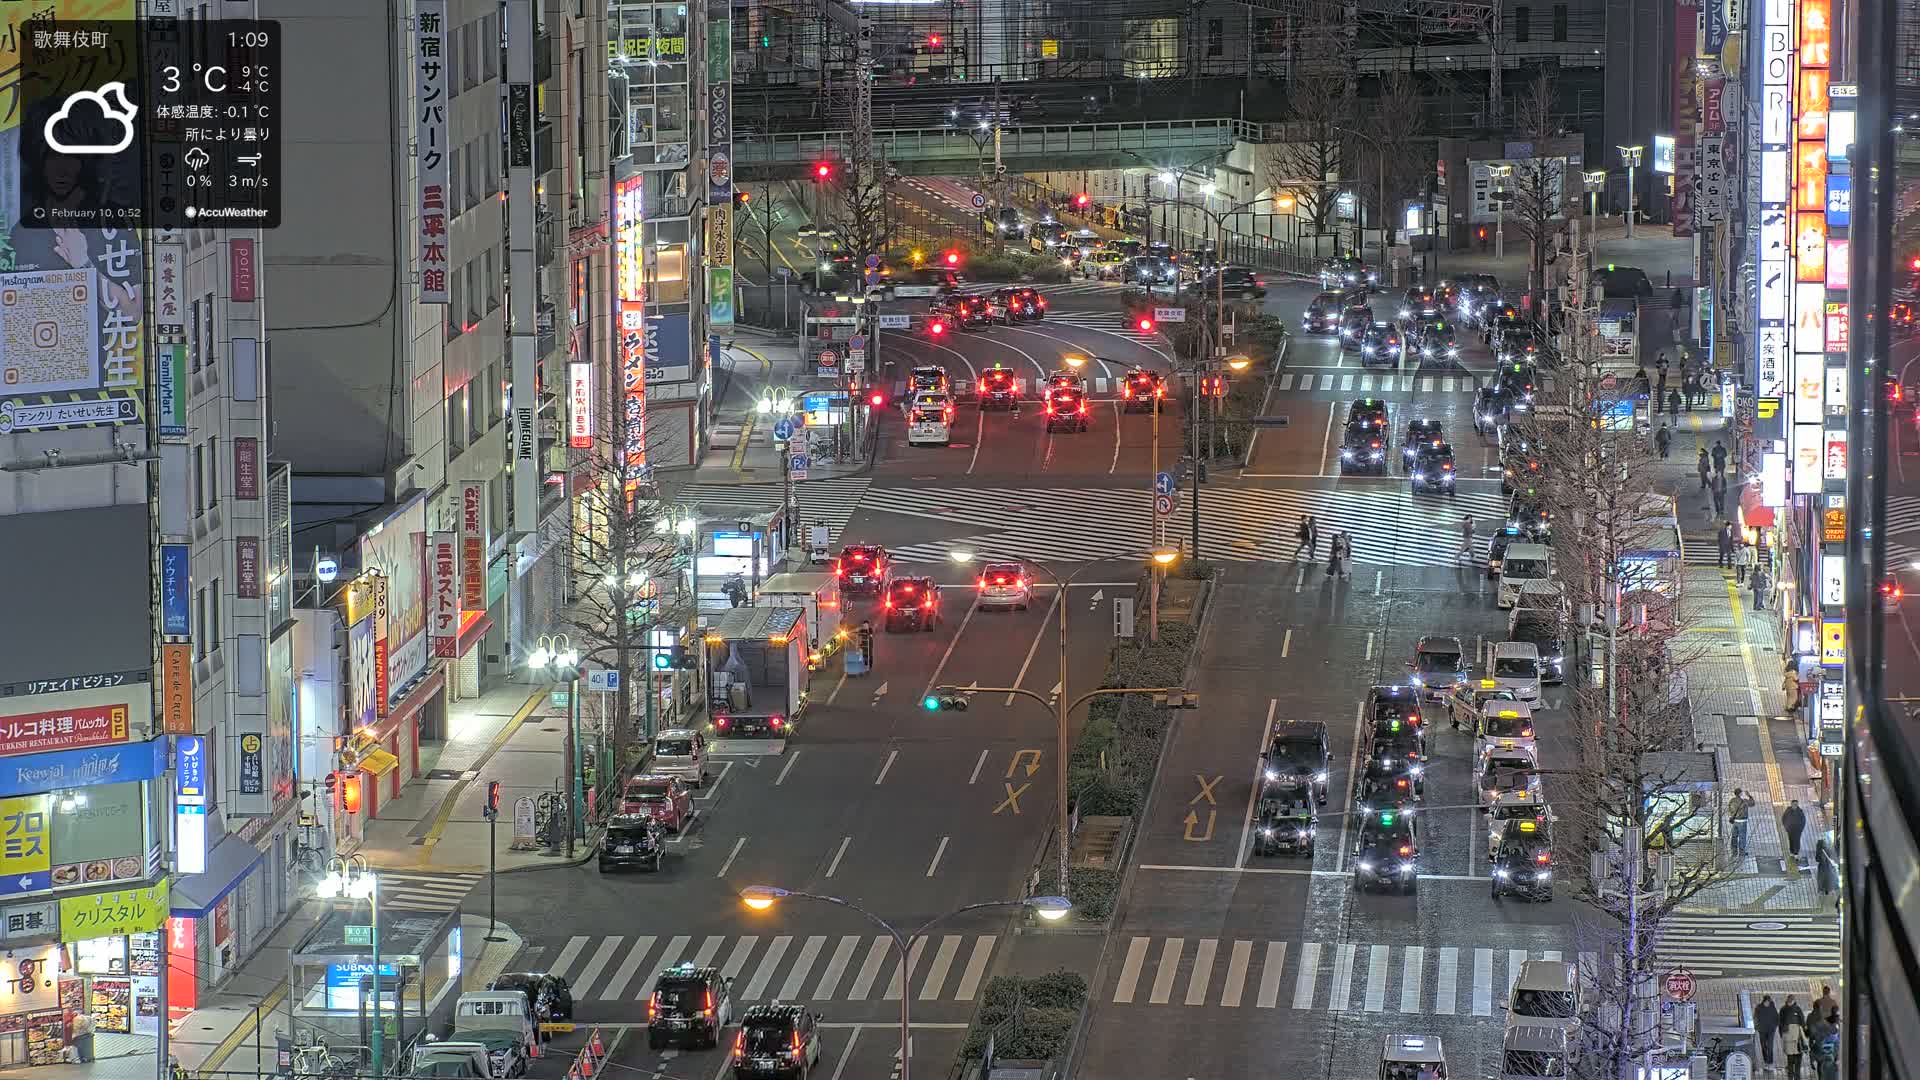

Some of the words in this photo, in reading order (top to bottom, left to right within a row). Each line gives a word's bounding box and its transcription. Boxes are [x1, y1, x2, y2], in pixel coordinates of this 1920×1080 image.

[1712, 0, 1721, 47] ントラル
[660, 37, 684, 54] 夜間
[420, 12, 443, 170] 新宿サンパーク
[1709, 88, 1720, 120] アコム
[423, 185, 445, 292] 三平本館
[715, 208, 727, 263] 肉汁水餃子
[624, 332, 640, 388] ラーメン
[1763, 331, 1775, 381] 大衆酒場
[161, 354, 173, 415] FamilyMart
[18, 409, 53, 422] テンクリ
[58, 405, 114, 420] たいせい先生
[519, 408, 532, 460] HOMEGAME
[465, 488, 475, 531] GAME
[164, 556, 176, 606] ゲウチャイ
[437, 543, 453, 630] 三平ストア
[28, 679, 79, 694] リアエイド
[82, 674, 123, 688] ビジョン
[114, 712, 122, 736] 5F
[29, 735, 73, 747] RESTAURANT
[247, 736, 258, 751] 占
[3, 812, 44, 836] プロ
[4, 838, 44, 858] ミス
[8, 912, 43, 932] 囲碁
[73, 904, 146, 927] クリスタル
[336, 964, 388, 973] SUBNAE
